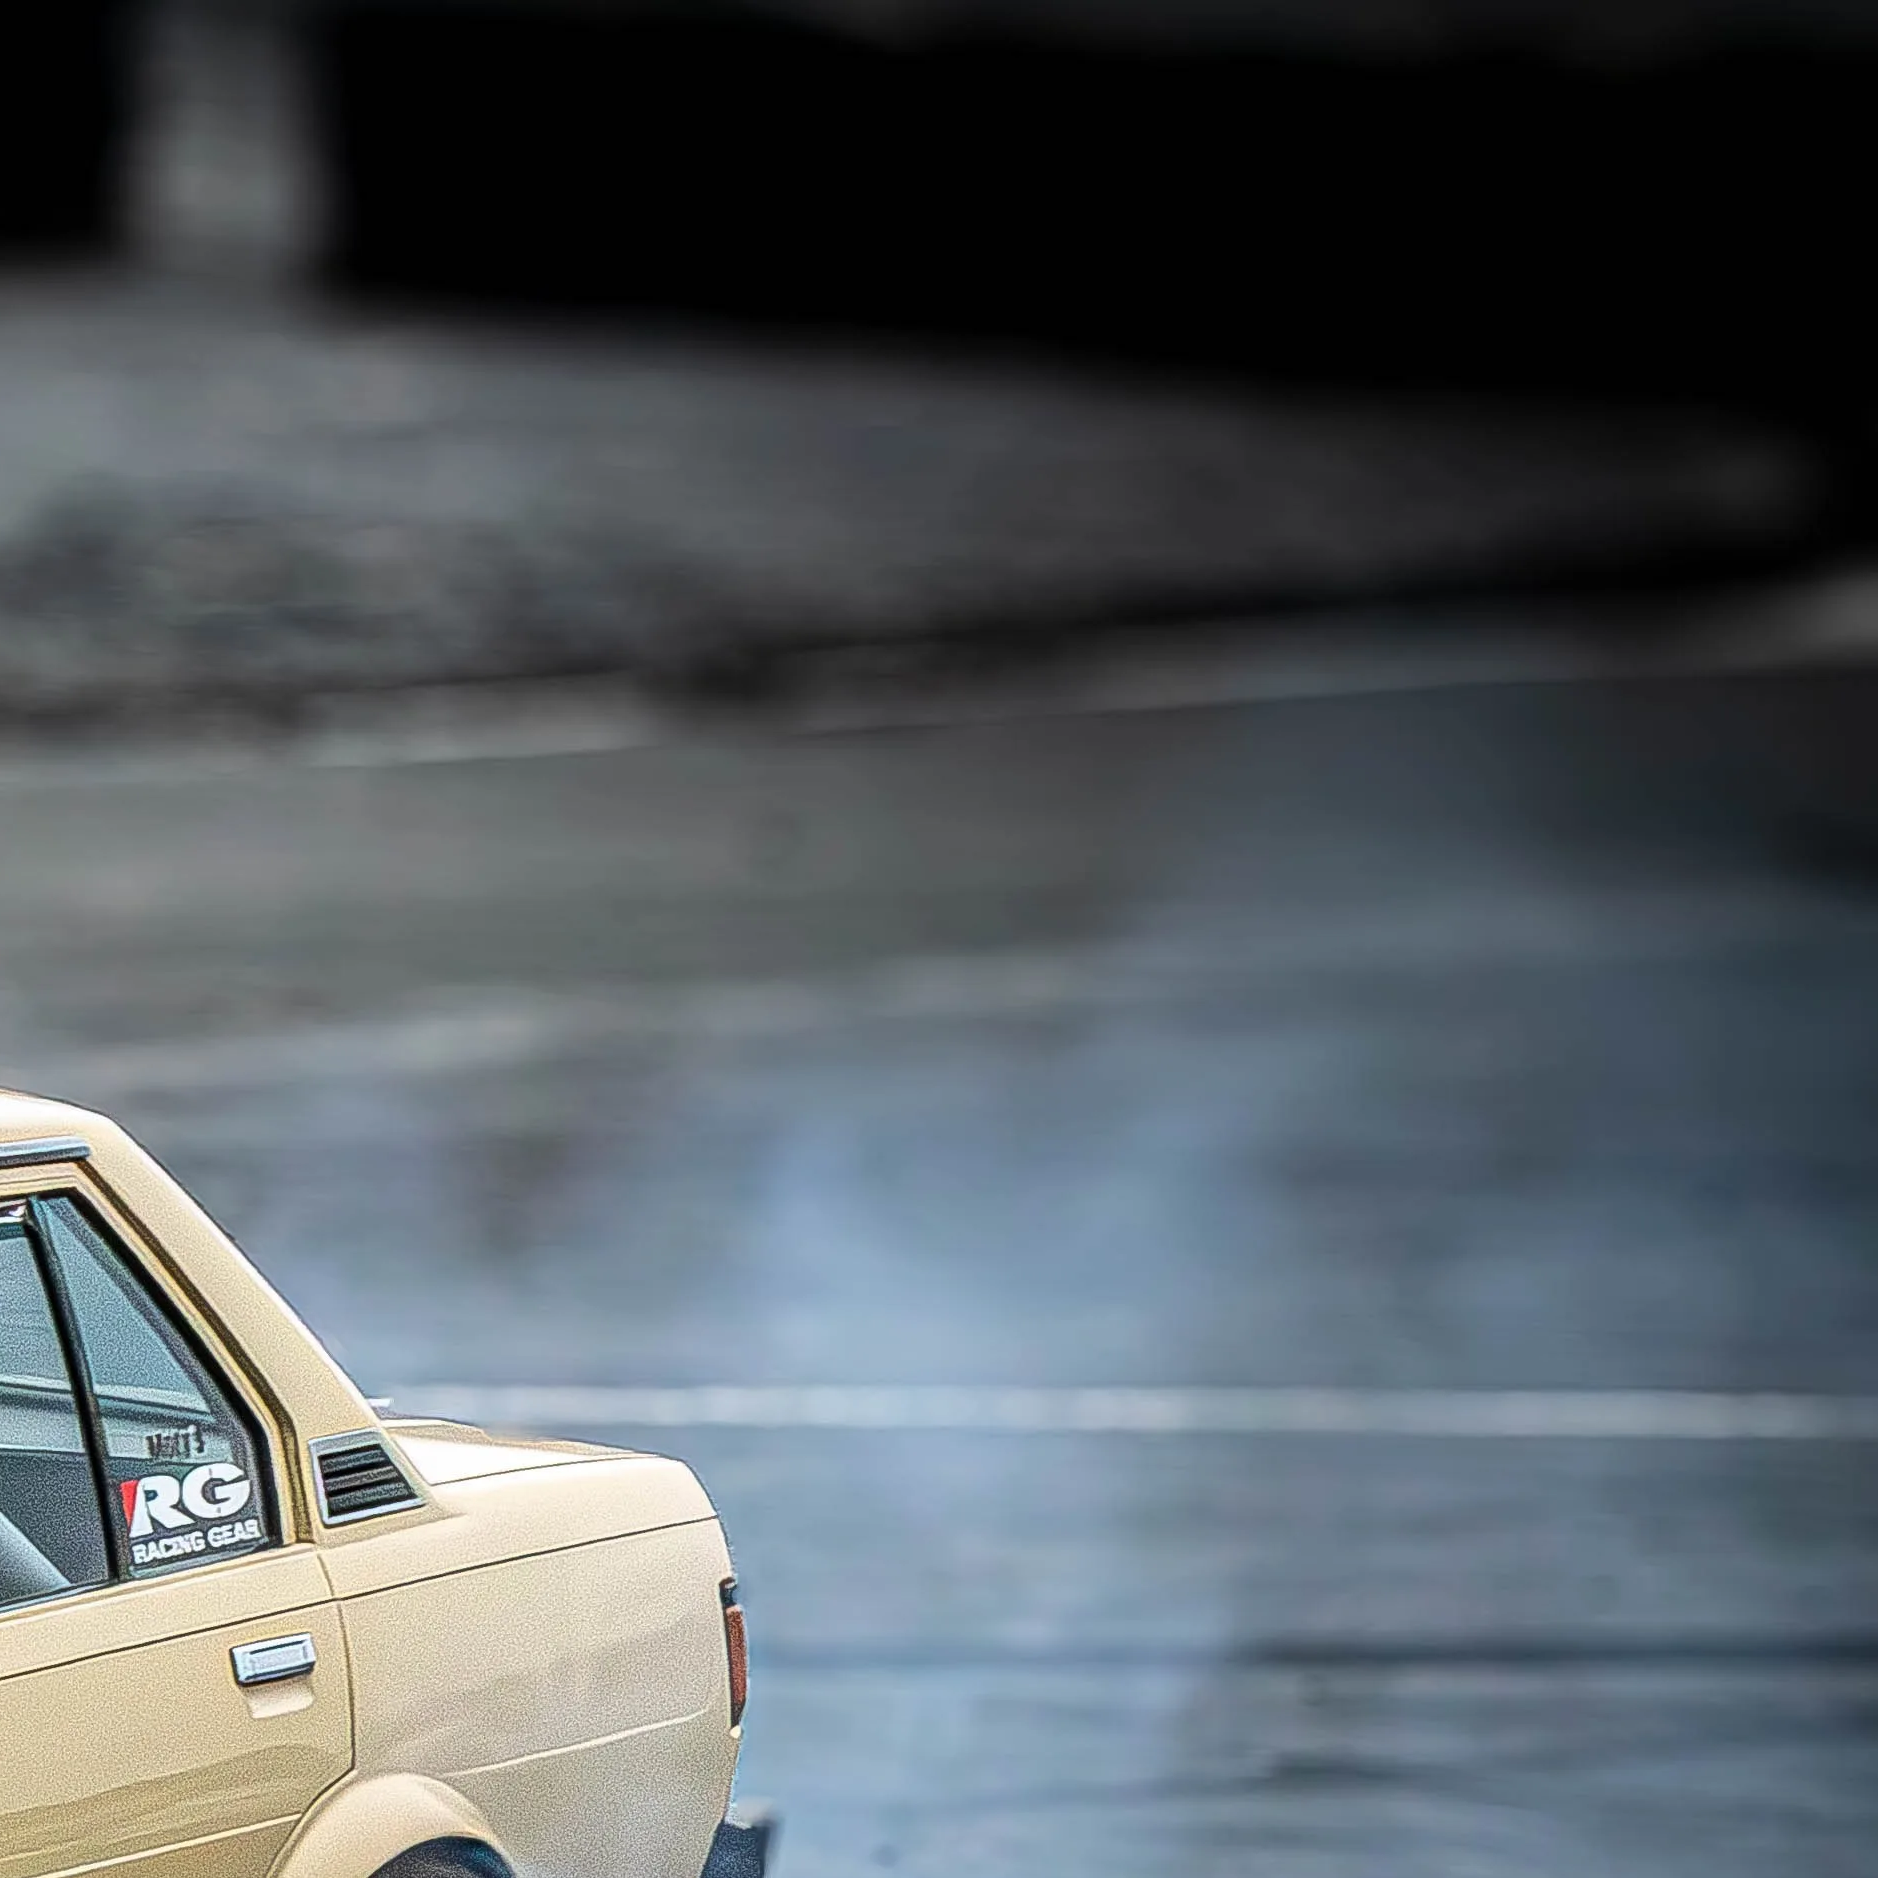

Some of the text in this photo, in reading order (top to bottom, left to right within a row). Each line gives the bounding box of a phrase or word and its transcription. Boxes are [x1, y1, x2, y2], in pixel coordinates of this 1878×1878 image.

[121, 1462, 251, 1538] RG
[131, 1519, 260, 1565] RACING GEAR
